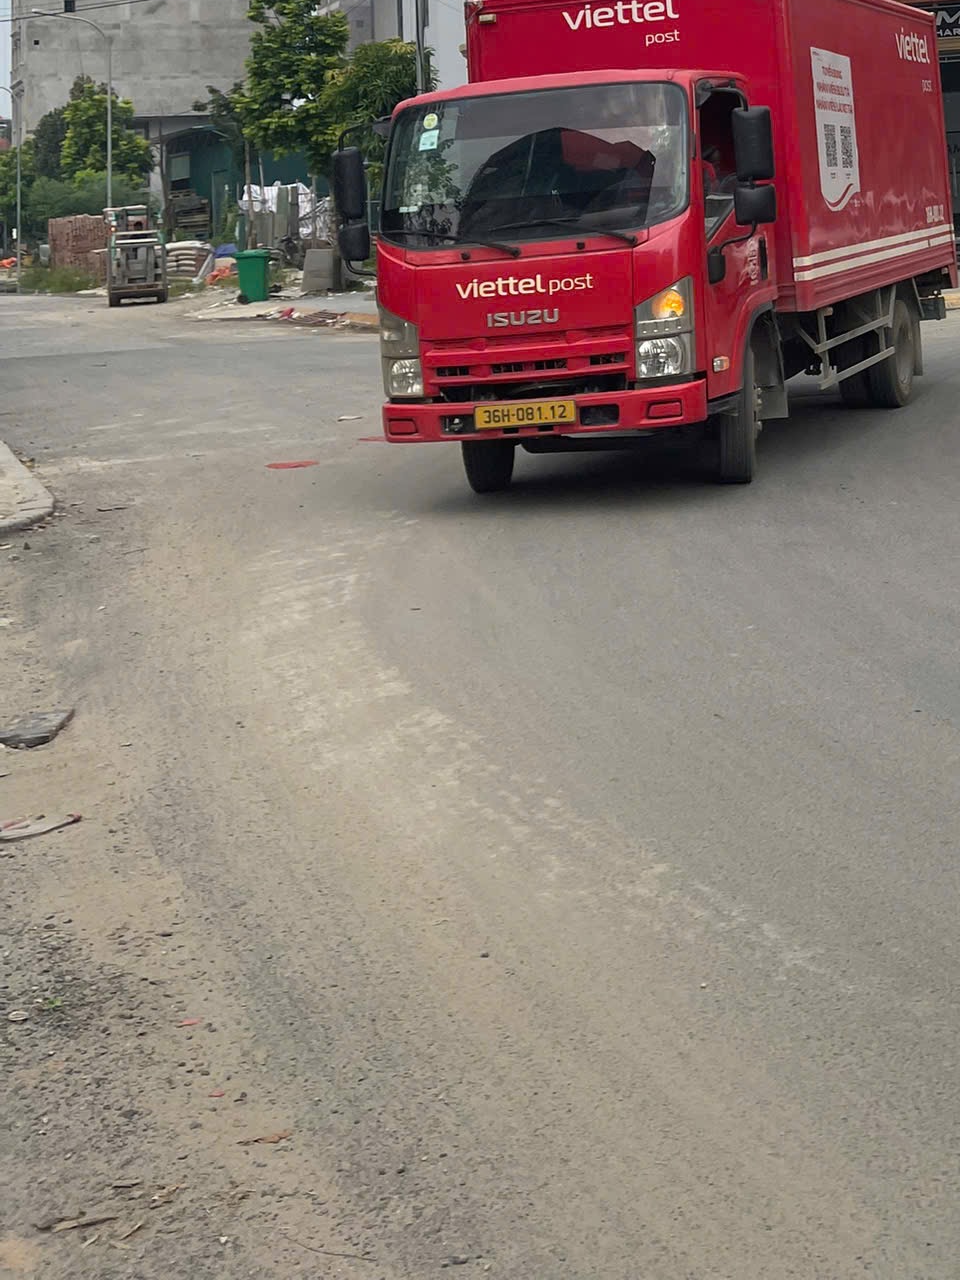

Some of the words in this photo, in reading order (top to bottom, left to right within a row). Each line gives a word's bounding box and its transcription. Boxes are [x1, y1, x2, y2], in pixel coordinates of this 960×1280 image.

[645, 29, 680, 47] post
[895, 27, 930, 64] viettel
[456, 274, 546, 299] viettel
[549, 273, 593, 295] post
[487, 308, 559, 328] ISUZU
[483, 404, 567, 424] 36H-081.12
